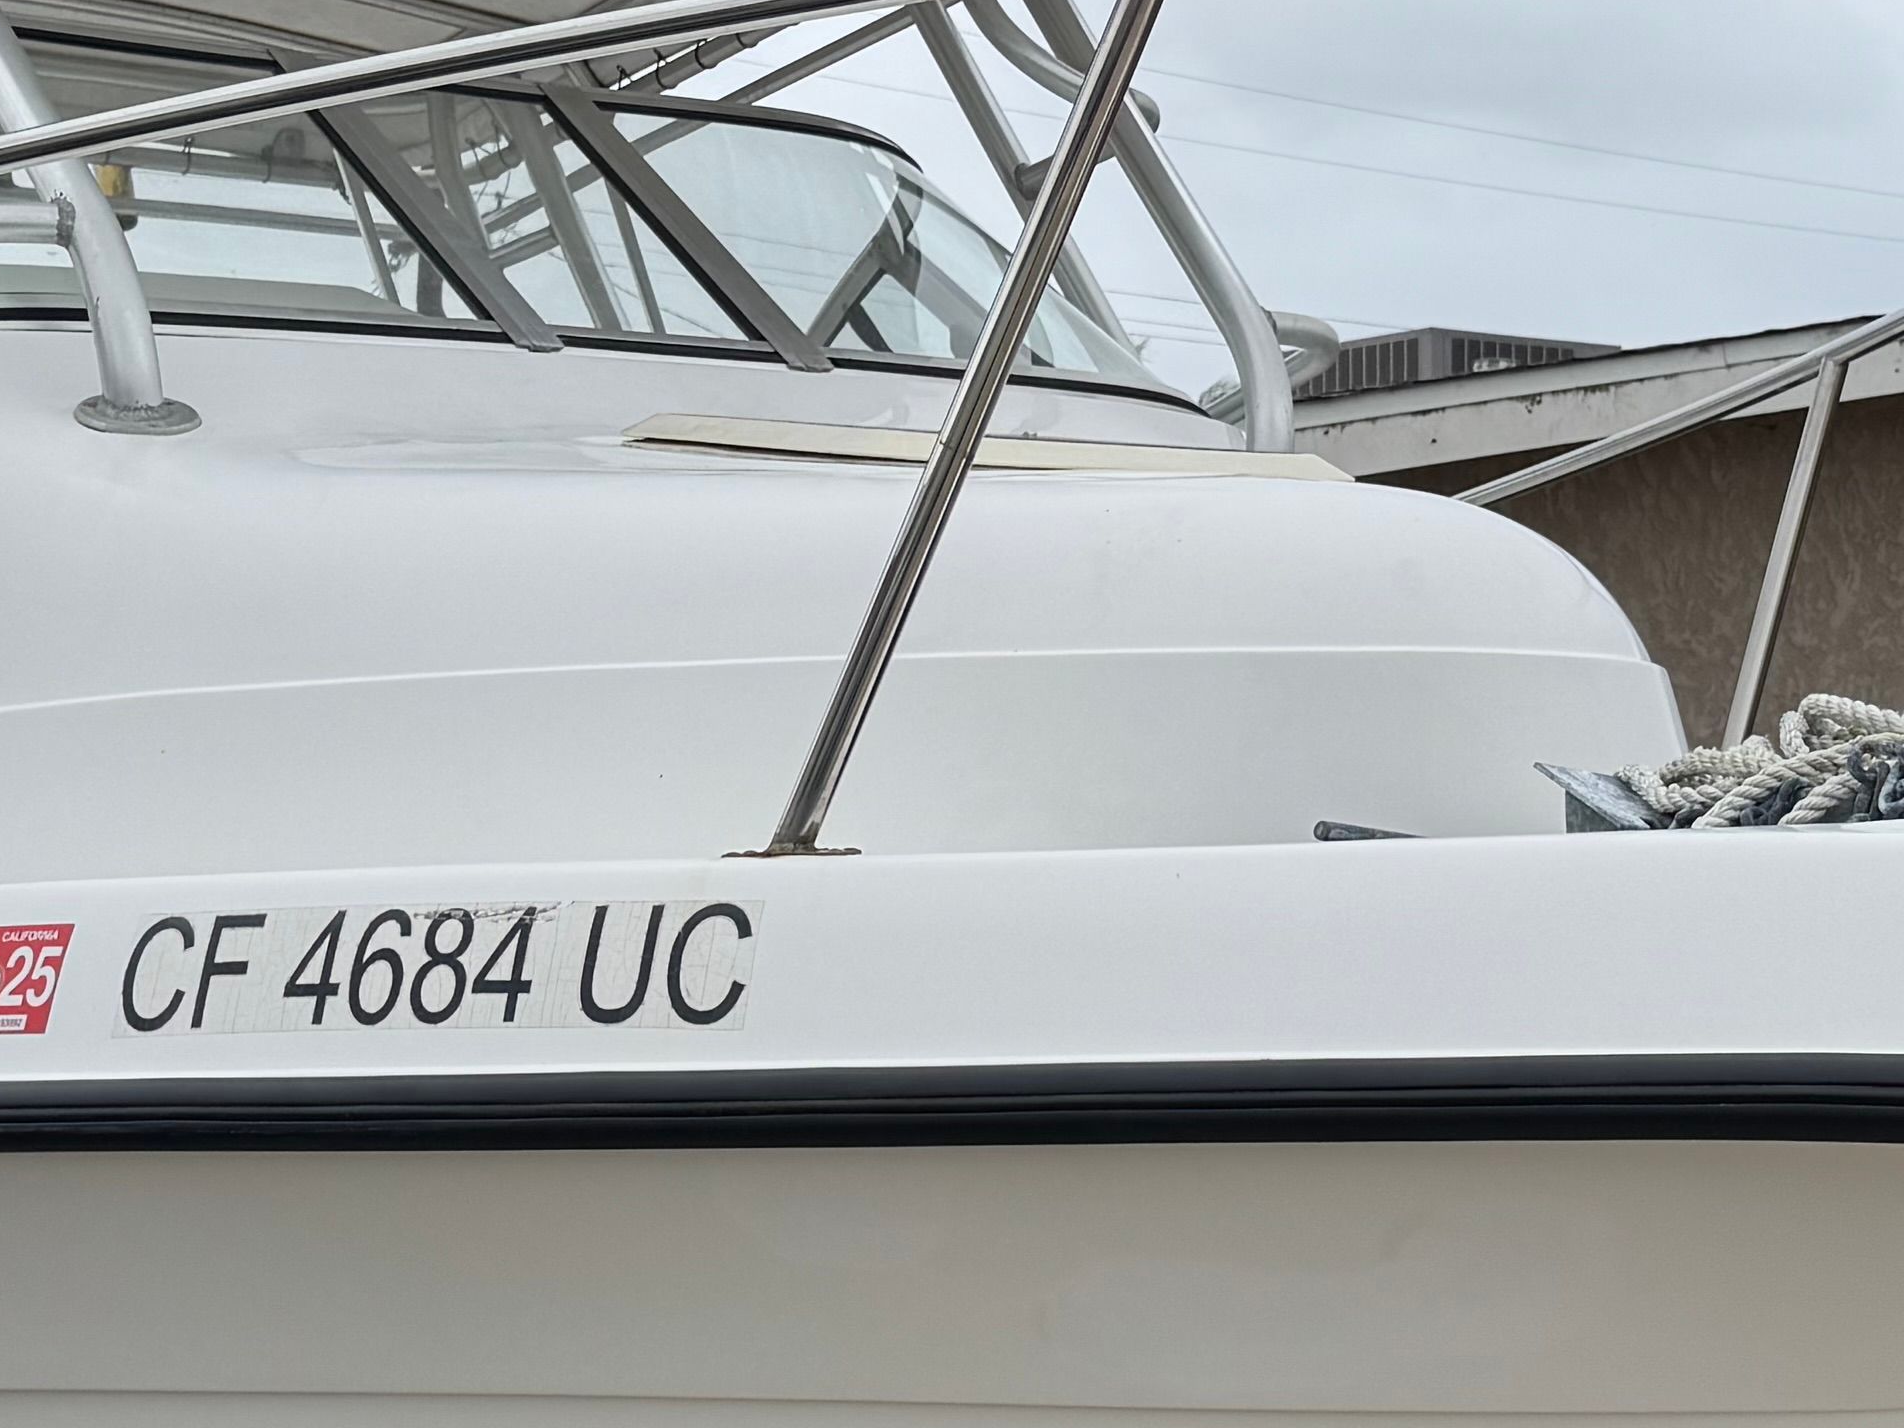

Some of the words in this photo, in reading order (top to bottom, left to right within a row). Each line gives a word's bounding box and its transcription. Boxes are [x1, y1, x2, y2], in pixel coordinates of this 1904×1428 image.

[122, 913, 268, 1032] CF
[283, 906, 537, 1026] 4684
[580, 903, 753, 1025] UC
